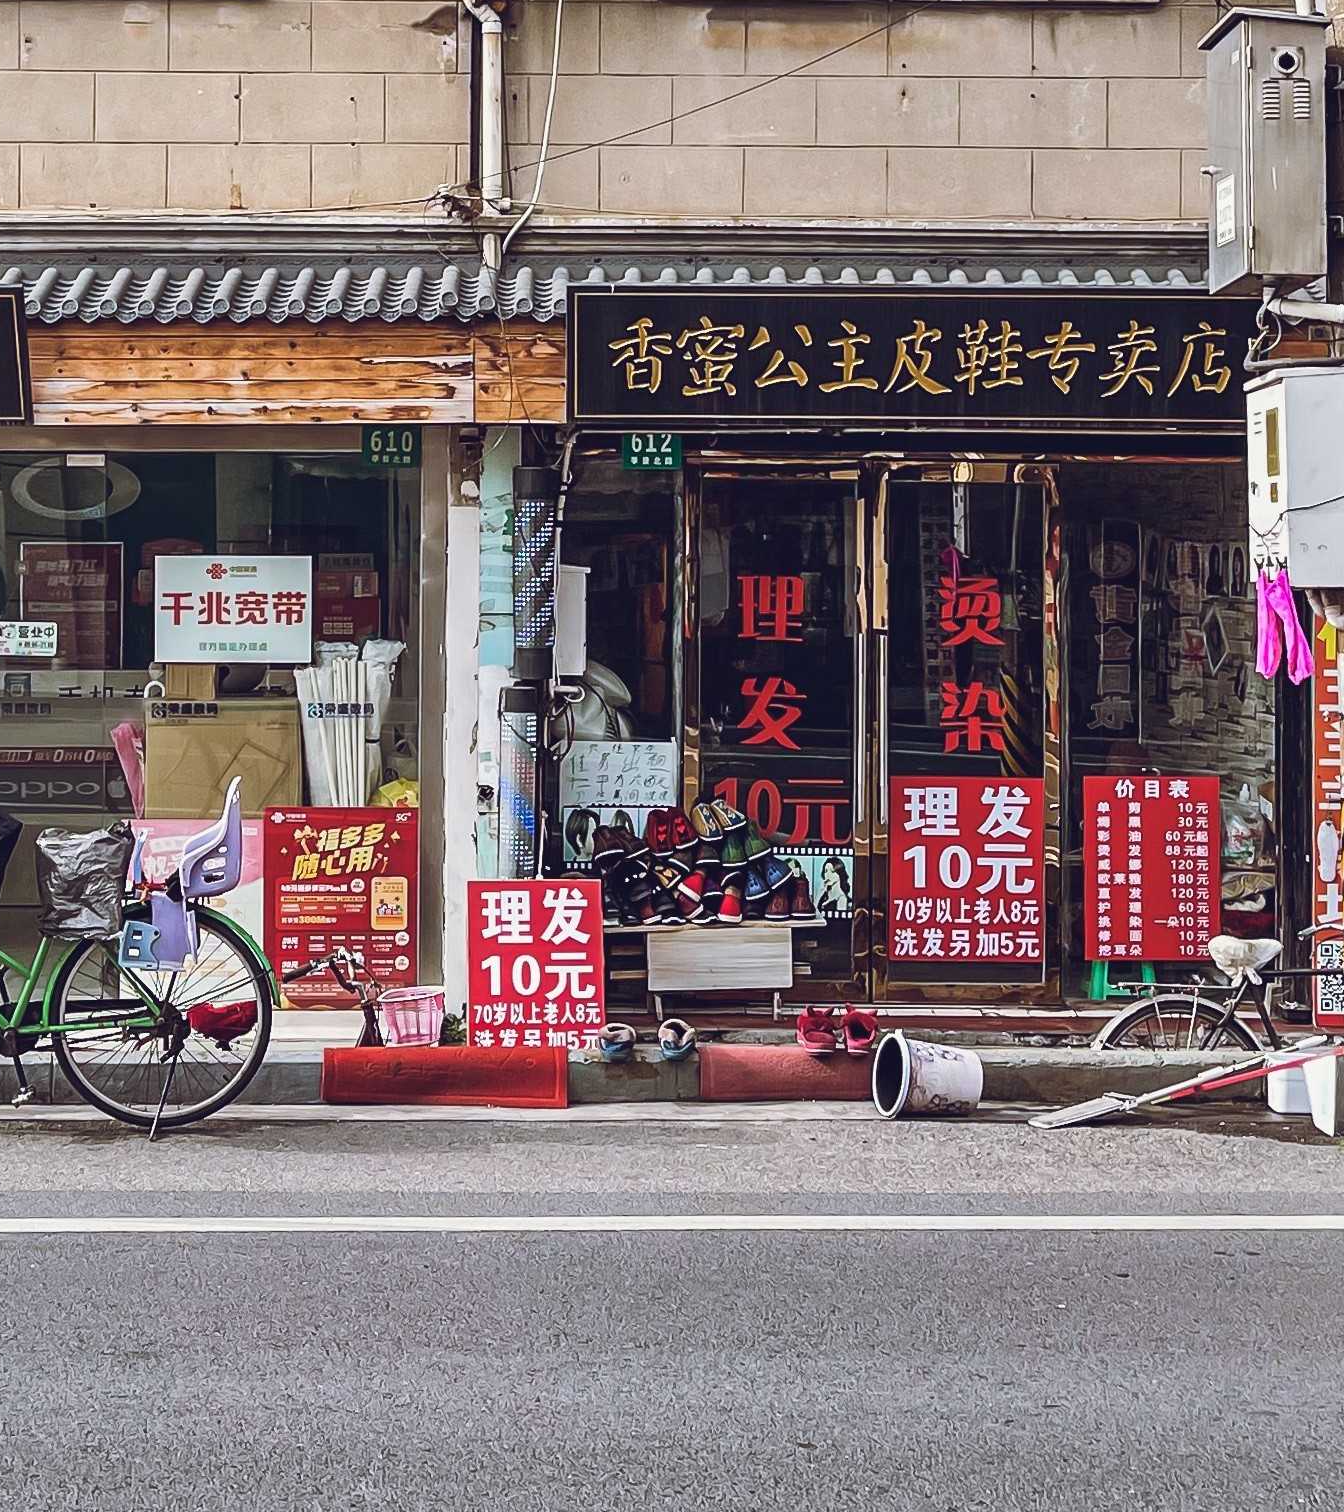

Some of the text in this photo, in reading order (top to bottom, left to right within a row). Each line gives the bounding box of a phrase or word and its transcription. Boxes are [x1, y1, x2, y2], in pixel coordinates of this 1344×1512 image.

[608, 316, 1233, 398] 香蜜公主皮鞋专卖店
[370, 431, 413, 453] 610
[632, 434, 673, 453] 612
[160, 591, 307, 626] 千兆宽带
[1114, 779, 1190, 799] 价目表
[903, 786, 1032, 838] 理发
[292, 846, 375, 881] 随心用
[903, 844, 1036, 894] 10元
[480, 888, 591, 946] 理发
[893, 898, 1040, 926] 70岁以上老人8元
[893, 928, 1040, 959] 洗发另加5元
[480, 952, 596, 1001] 10元
[473, 1003, 601, 1025] 70岁以上老人8元
